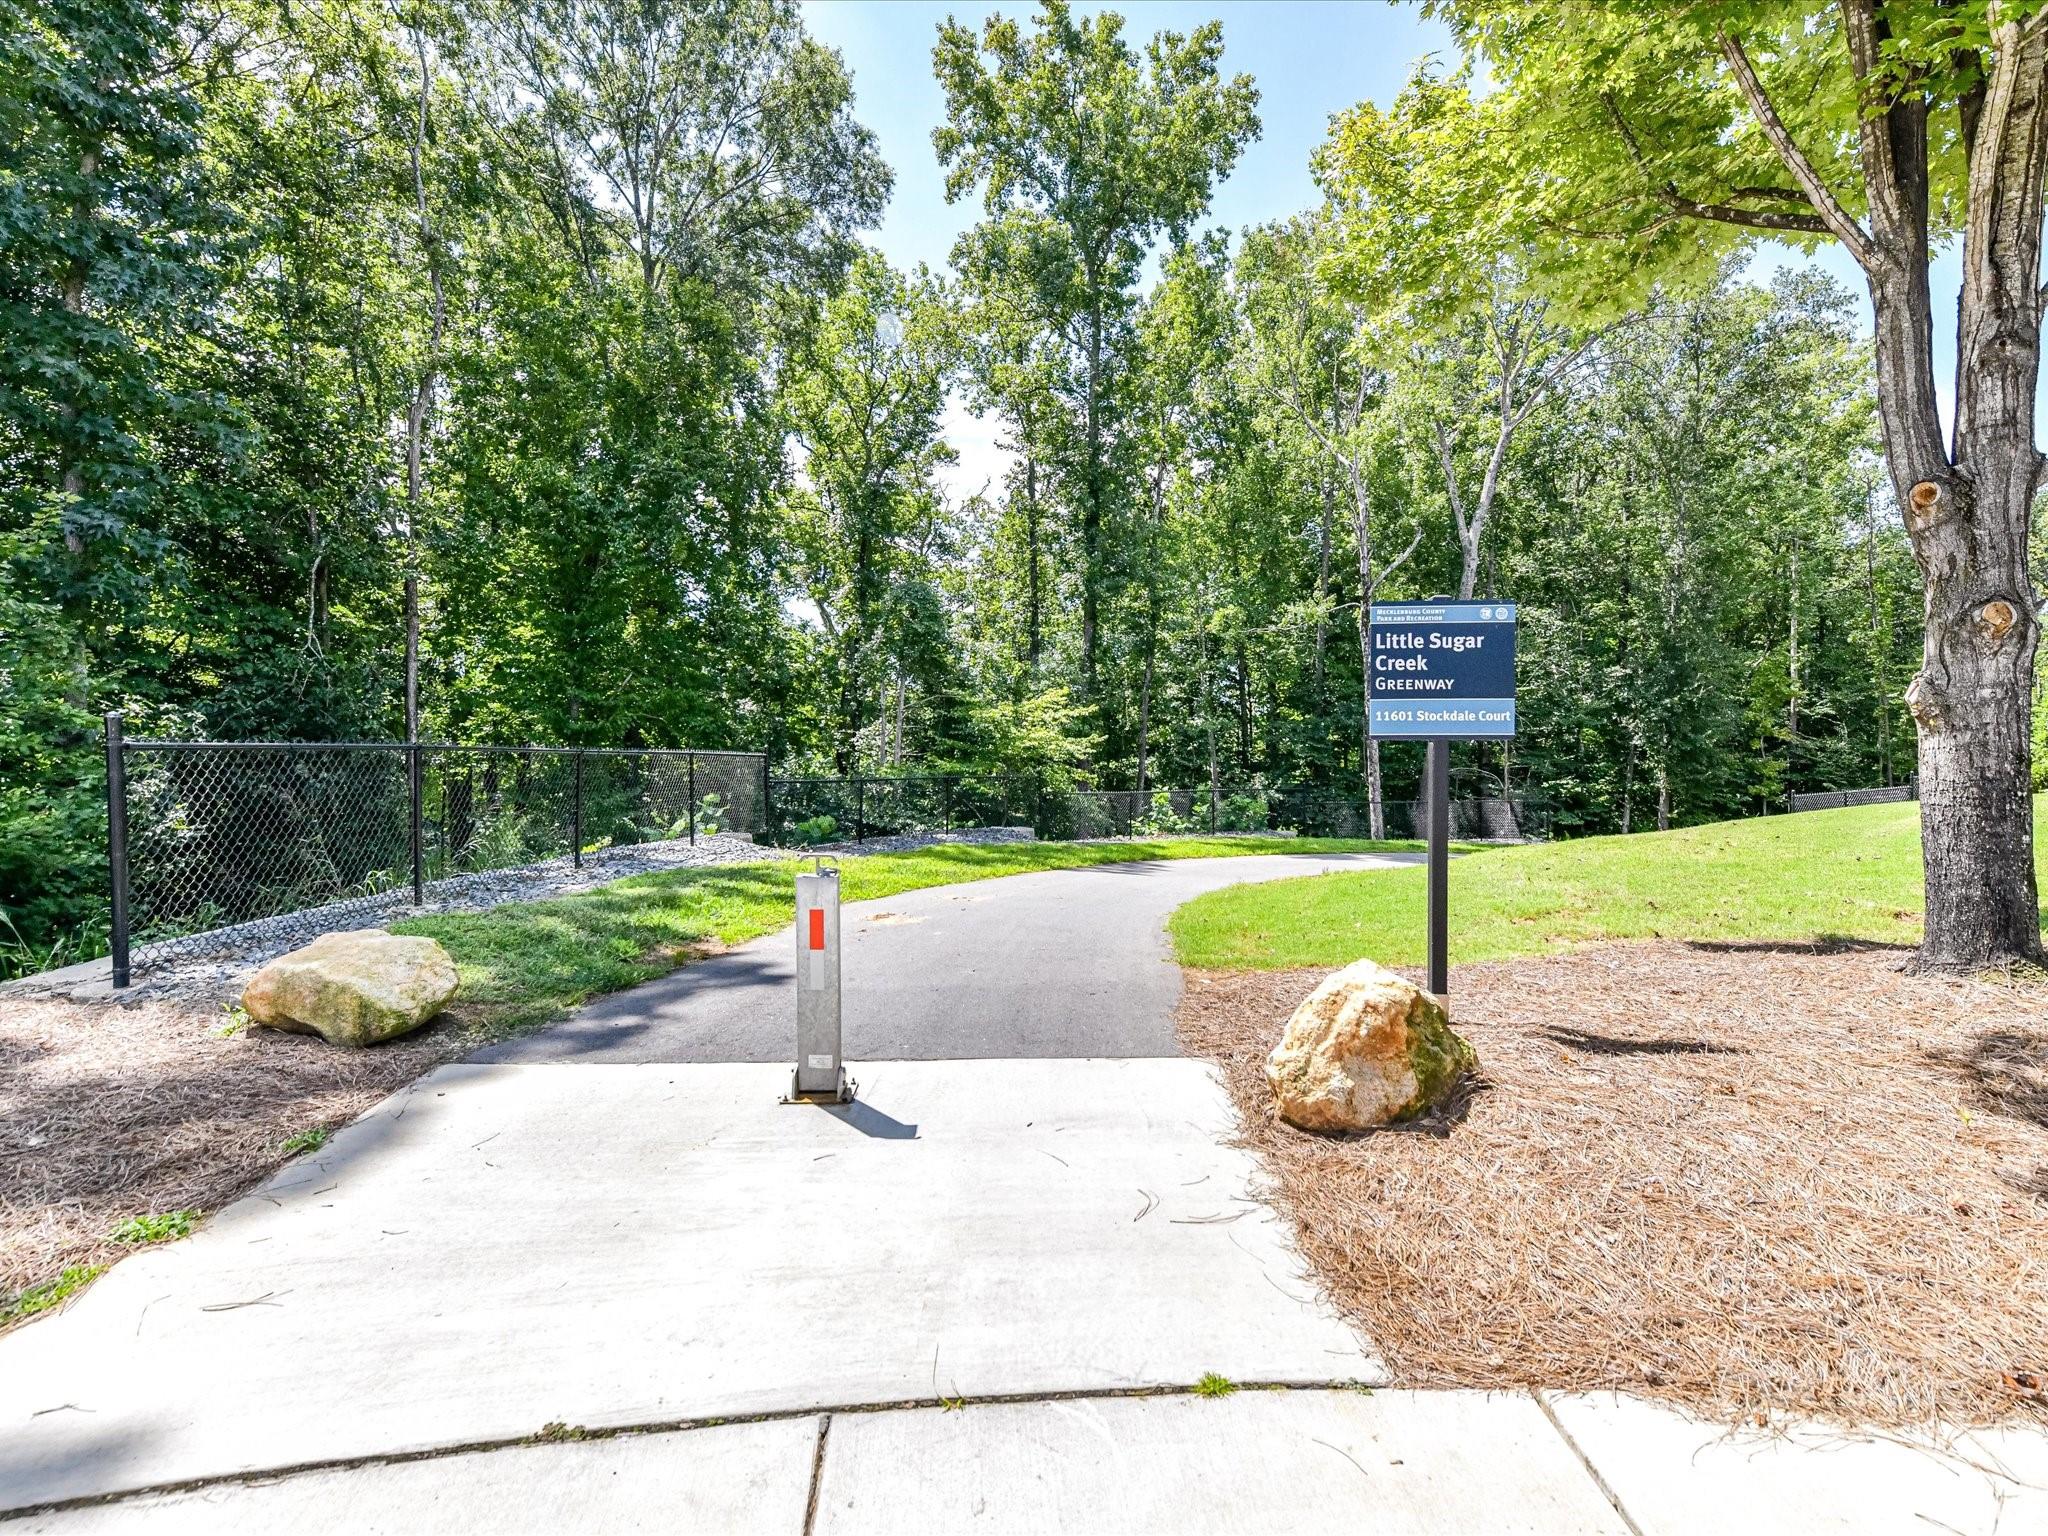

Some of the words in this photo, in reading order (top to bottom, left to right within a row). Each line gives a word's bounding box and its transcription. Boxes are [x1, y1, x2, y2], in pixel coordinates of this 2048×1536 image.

[1375, 632, 1424, 649] Little
[1429, 632, 1484, 652] Sugar
[1375, 654, 1428, 671] Creek
[1375, 677, 1454, 690] GREENWAY
[1375, 711, 1413, 721] 11601
[1417, 710, 1476, 721] Stockdale
[1478, 710, 1511, 721] Court
